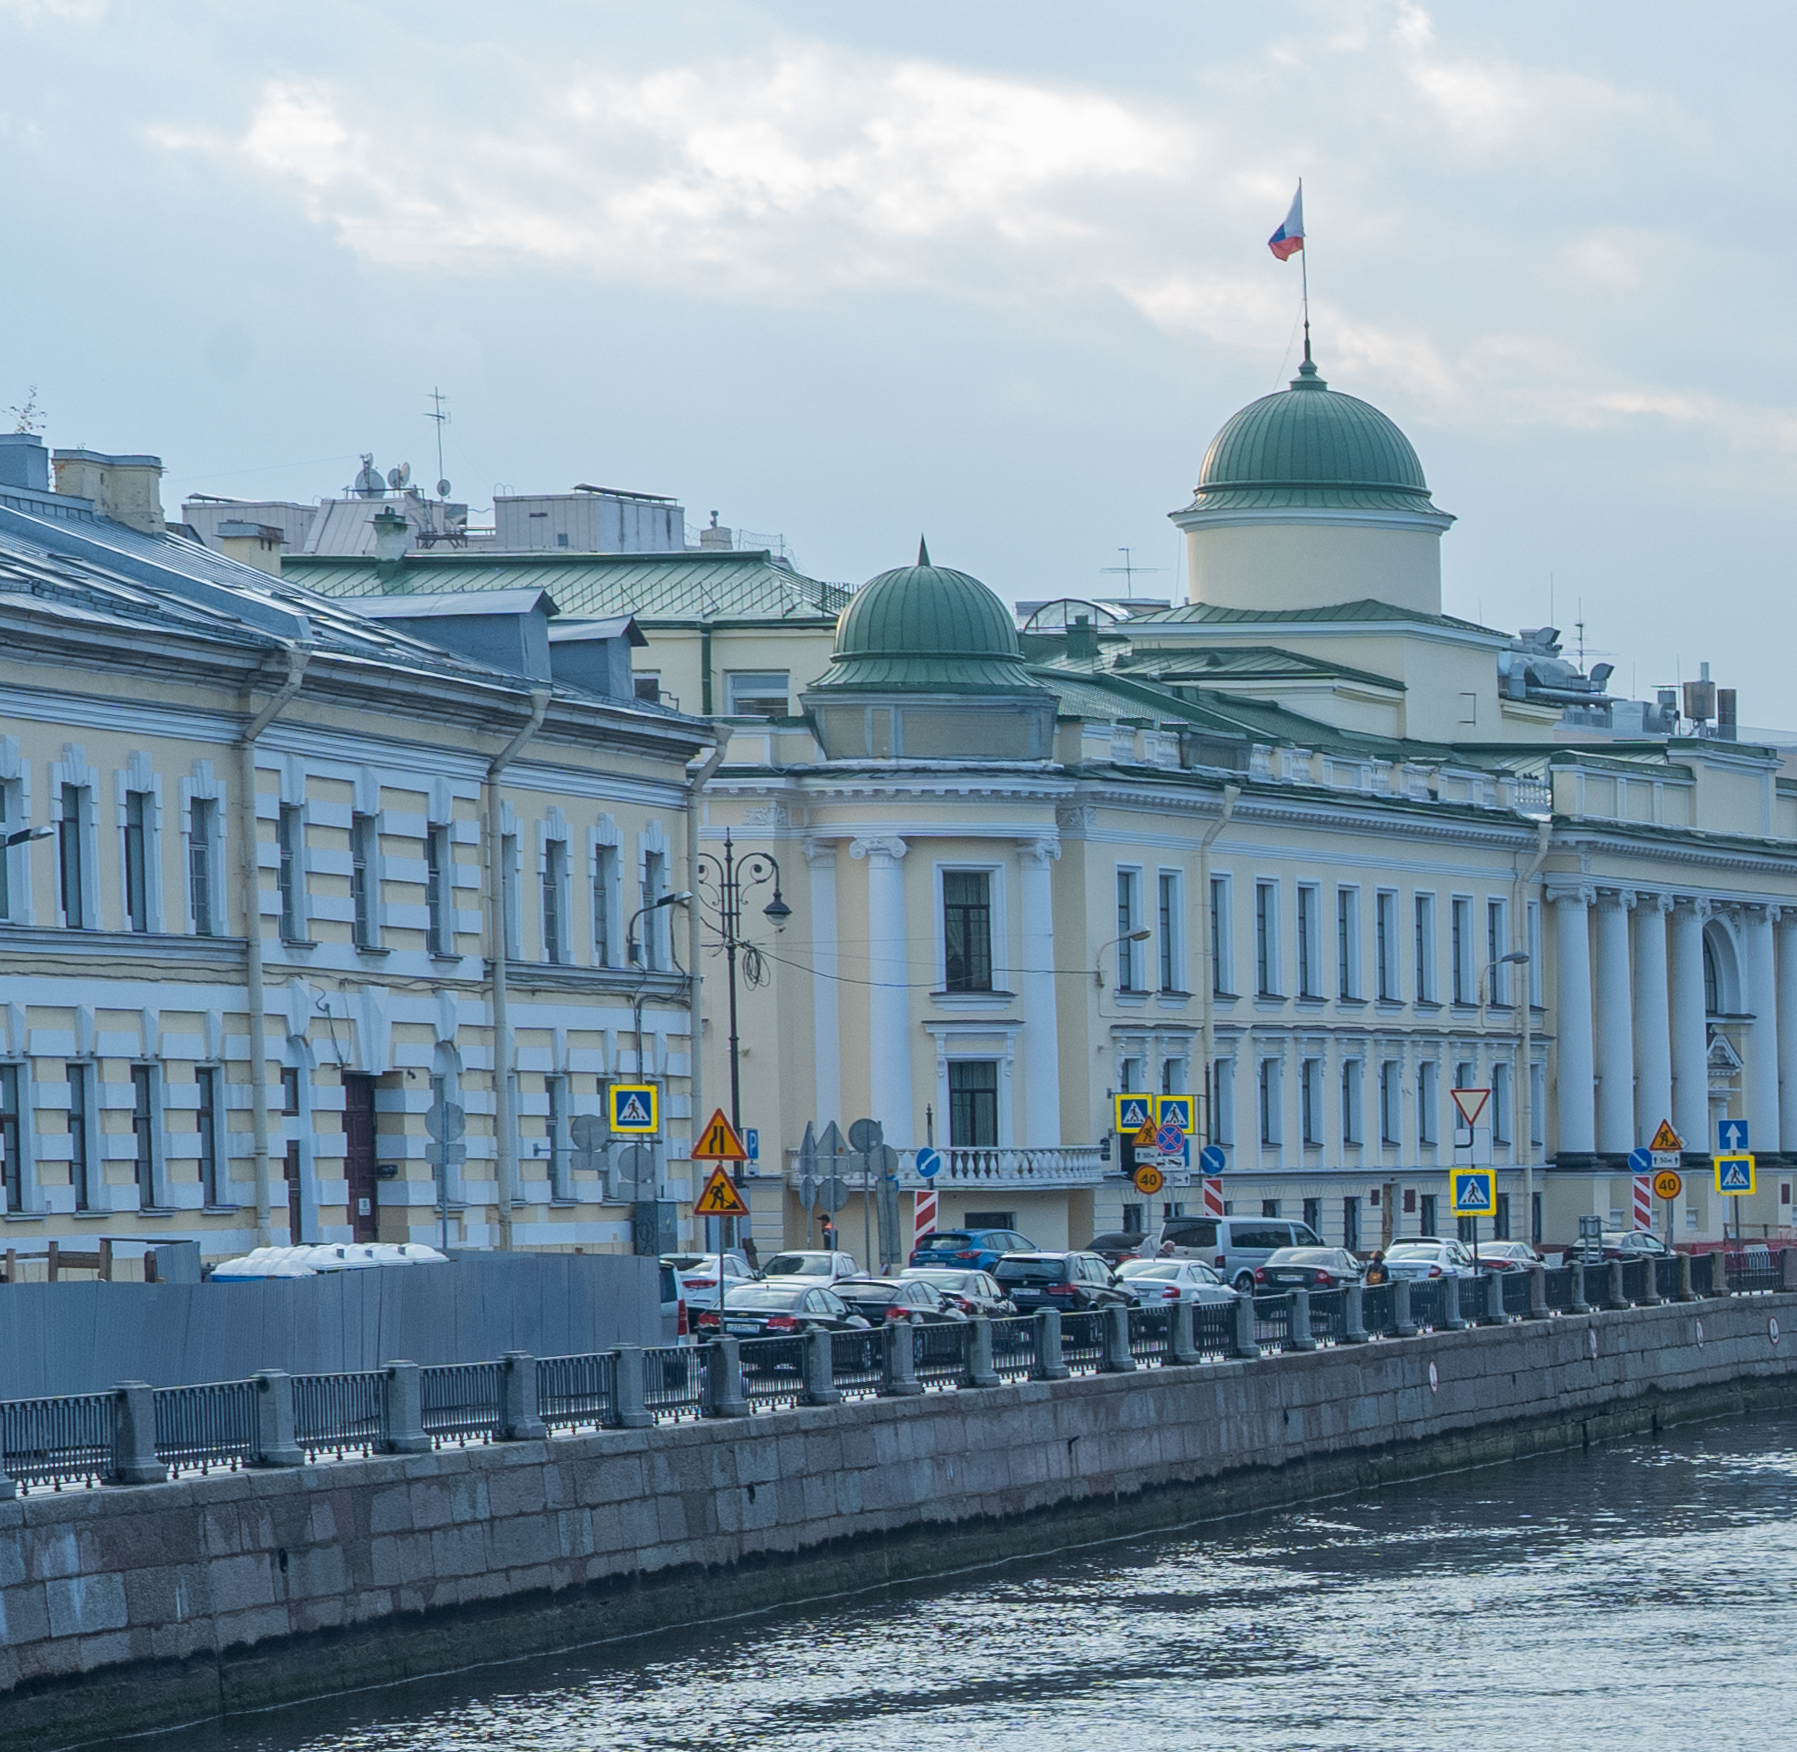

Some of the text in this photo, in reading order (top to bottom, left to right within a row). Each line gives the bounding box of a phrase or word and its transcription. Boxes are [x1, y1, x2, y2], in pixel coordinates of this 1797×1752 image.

[750, 1131, 757, 1156] P
[1140, 1174, 1157, 1185] 40
[1659, 1179, 1676, 1191] 40
